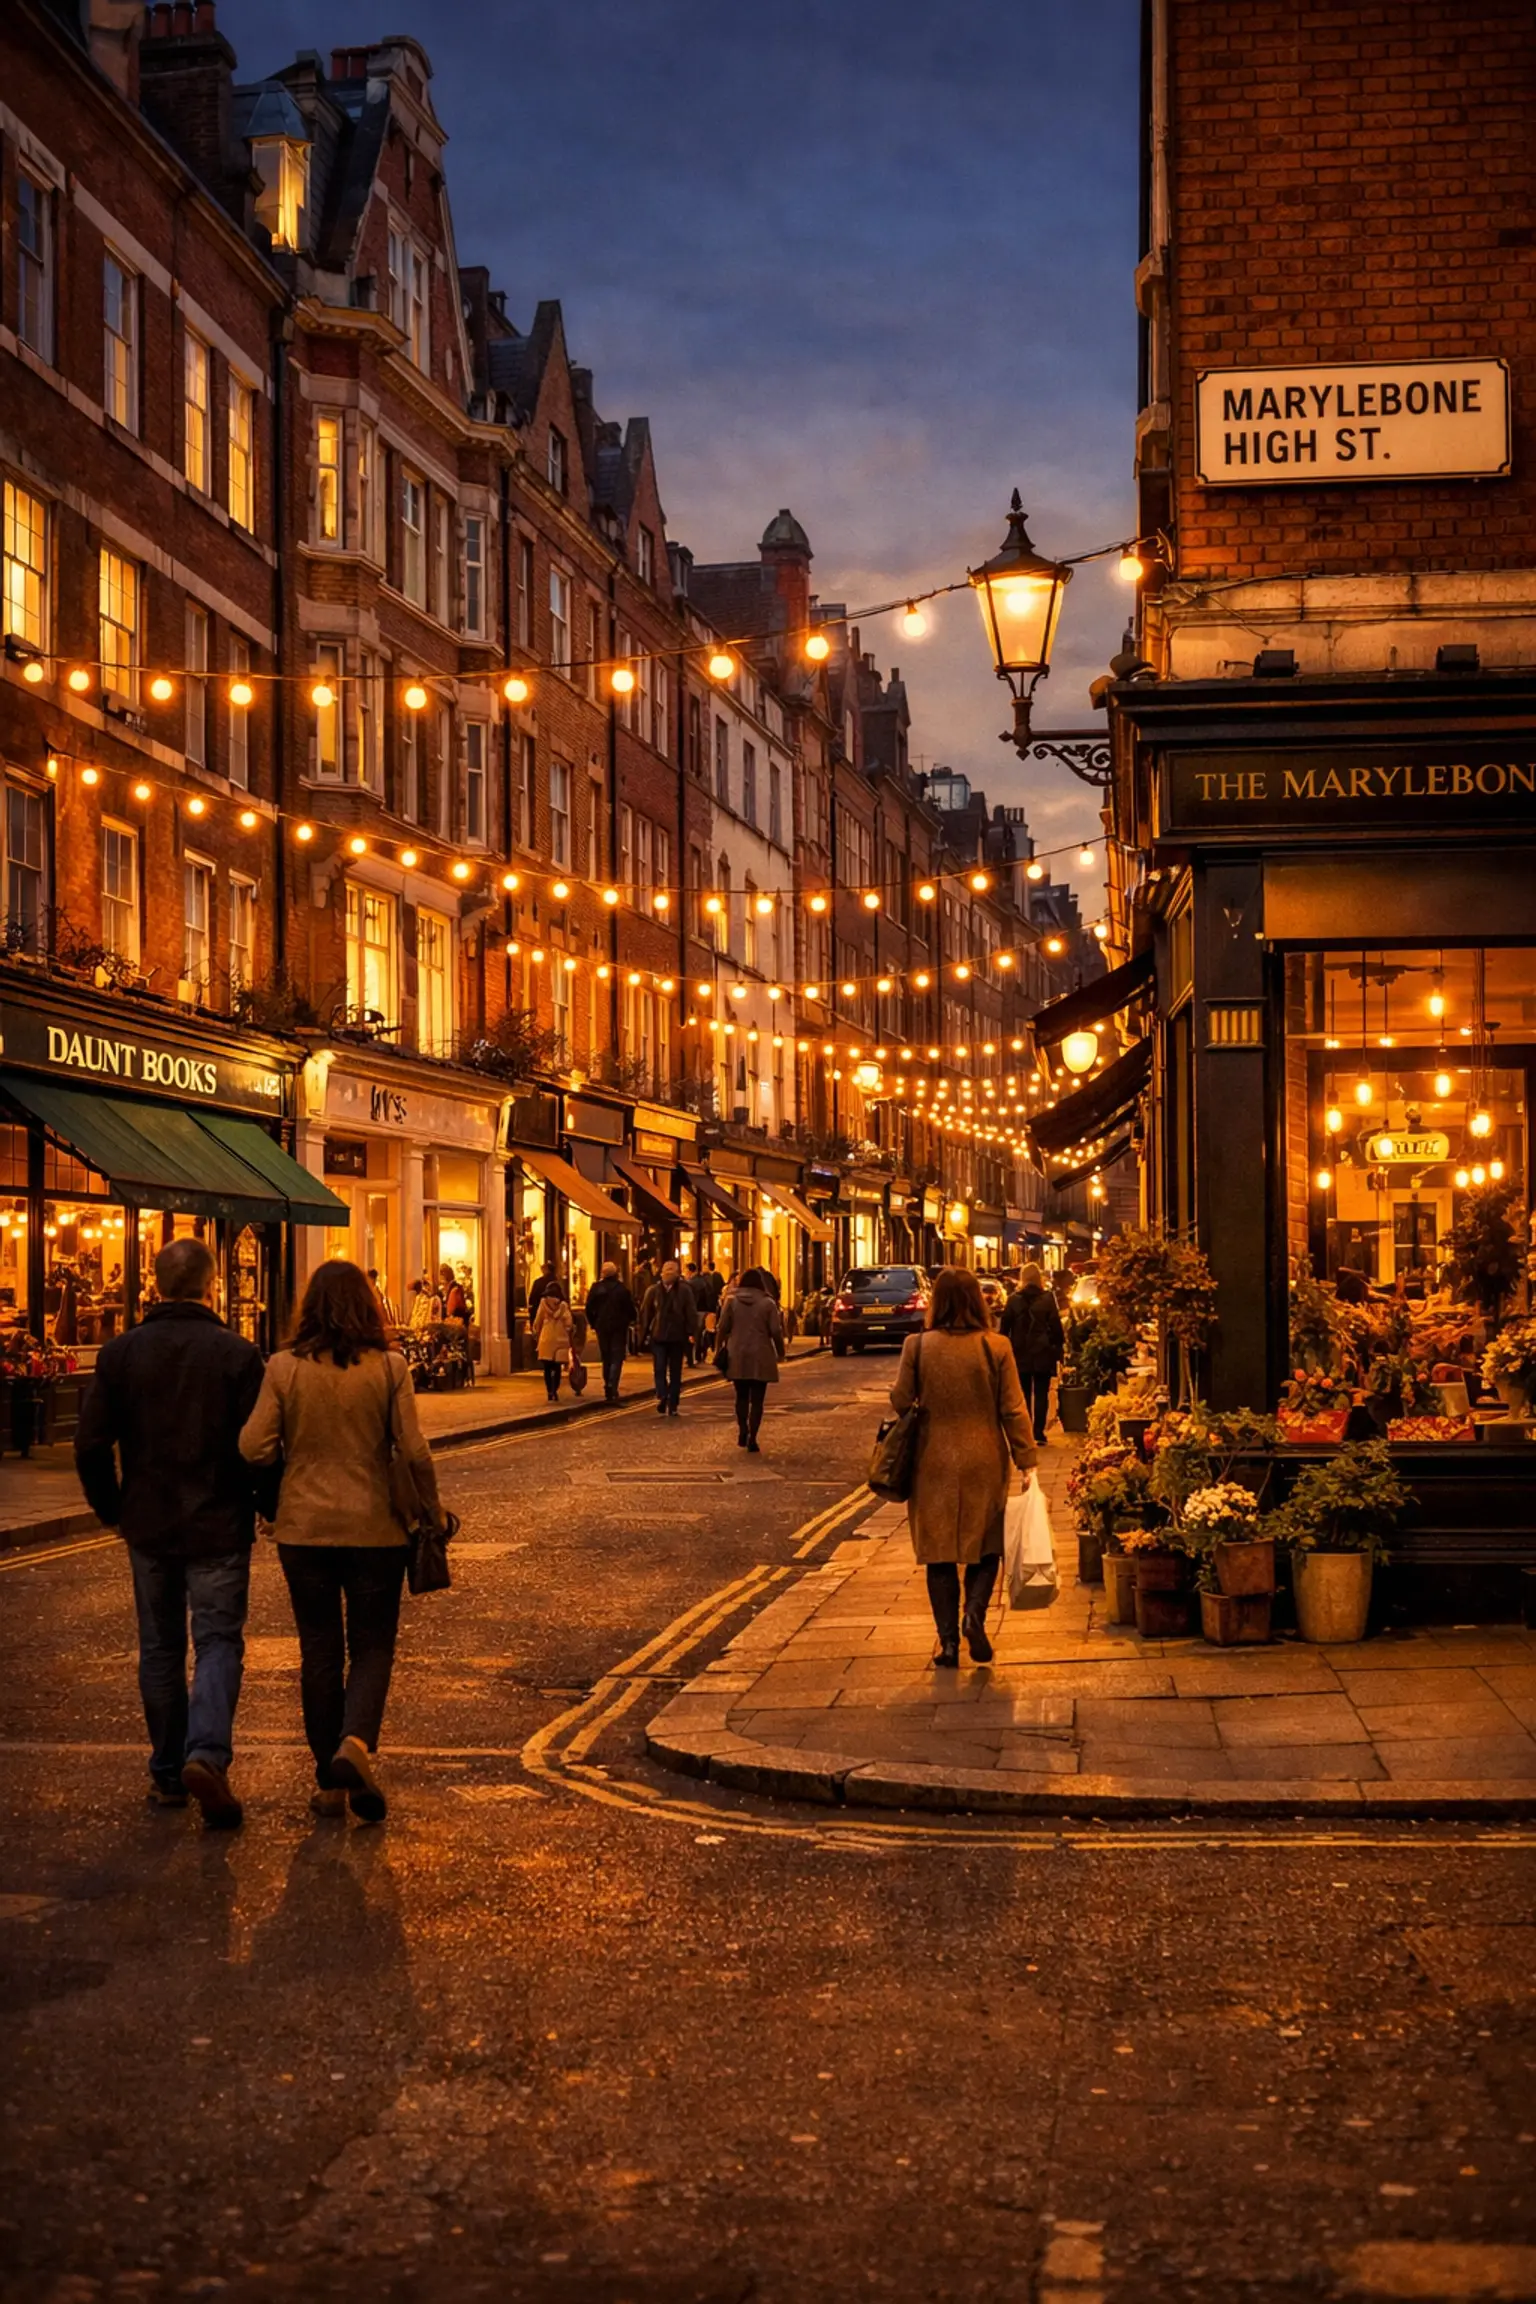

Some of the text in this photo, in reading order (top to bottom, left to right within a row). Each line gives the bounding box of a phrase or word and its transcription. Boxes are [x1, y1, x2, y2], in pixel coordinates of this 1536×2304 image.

[1223, 379, 1482, 421] MARYLEBONE
[1224, 427, 1391, 465] HIGH ST.
[1195, 763, 1536, 801] THE MARYLEBON
[47, 1026, 137, 1077] DAUNT
[141, 1048, 217, 1095] BOOKS
